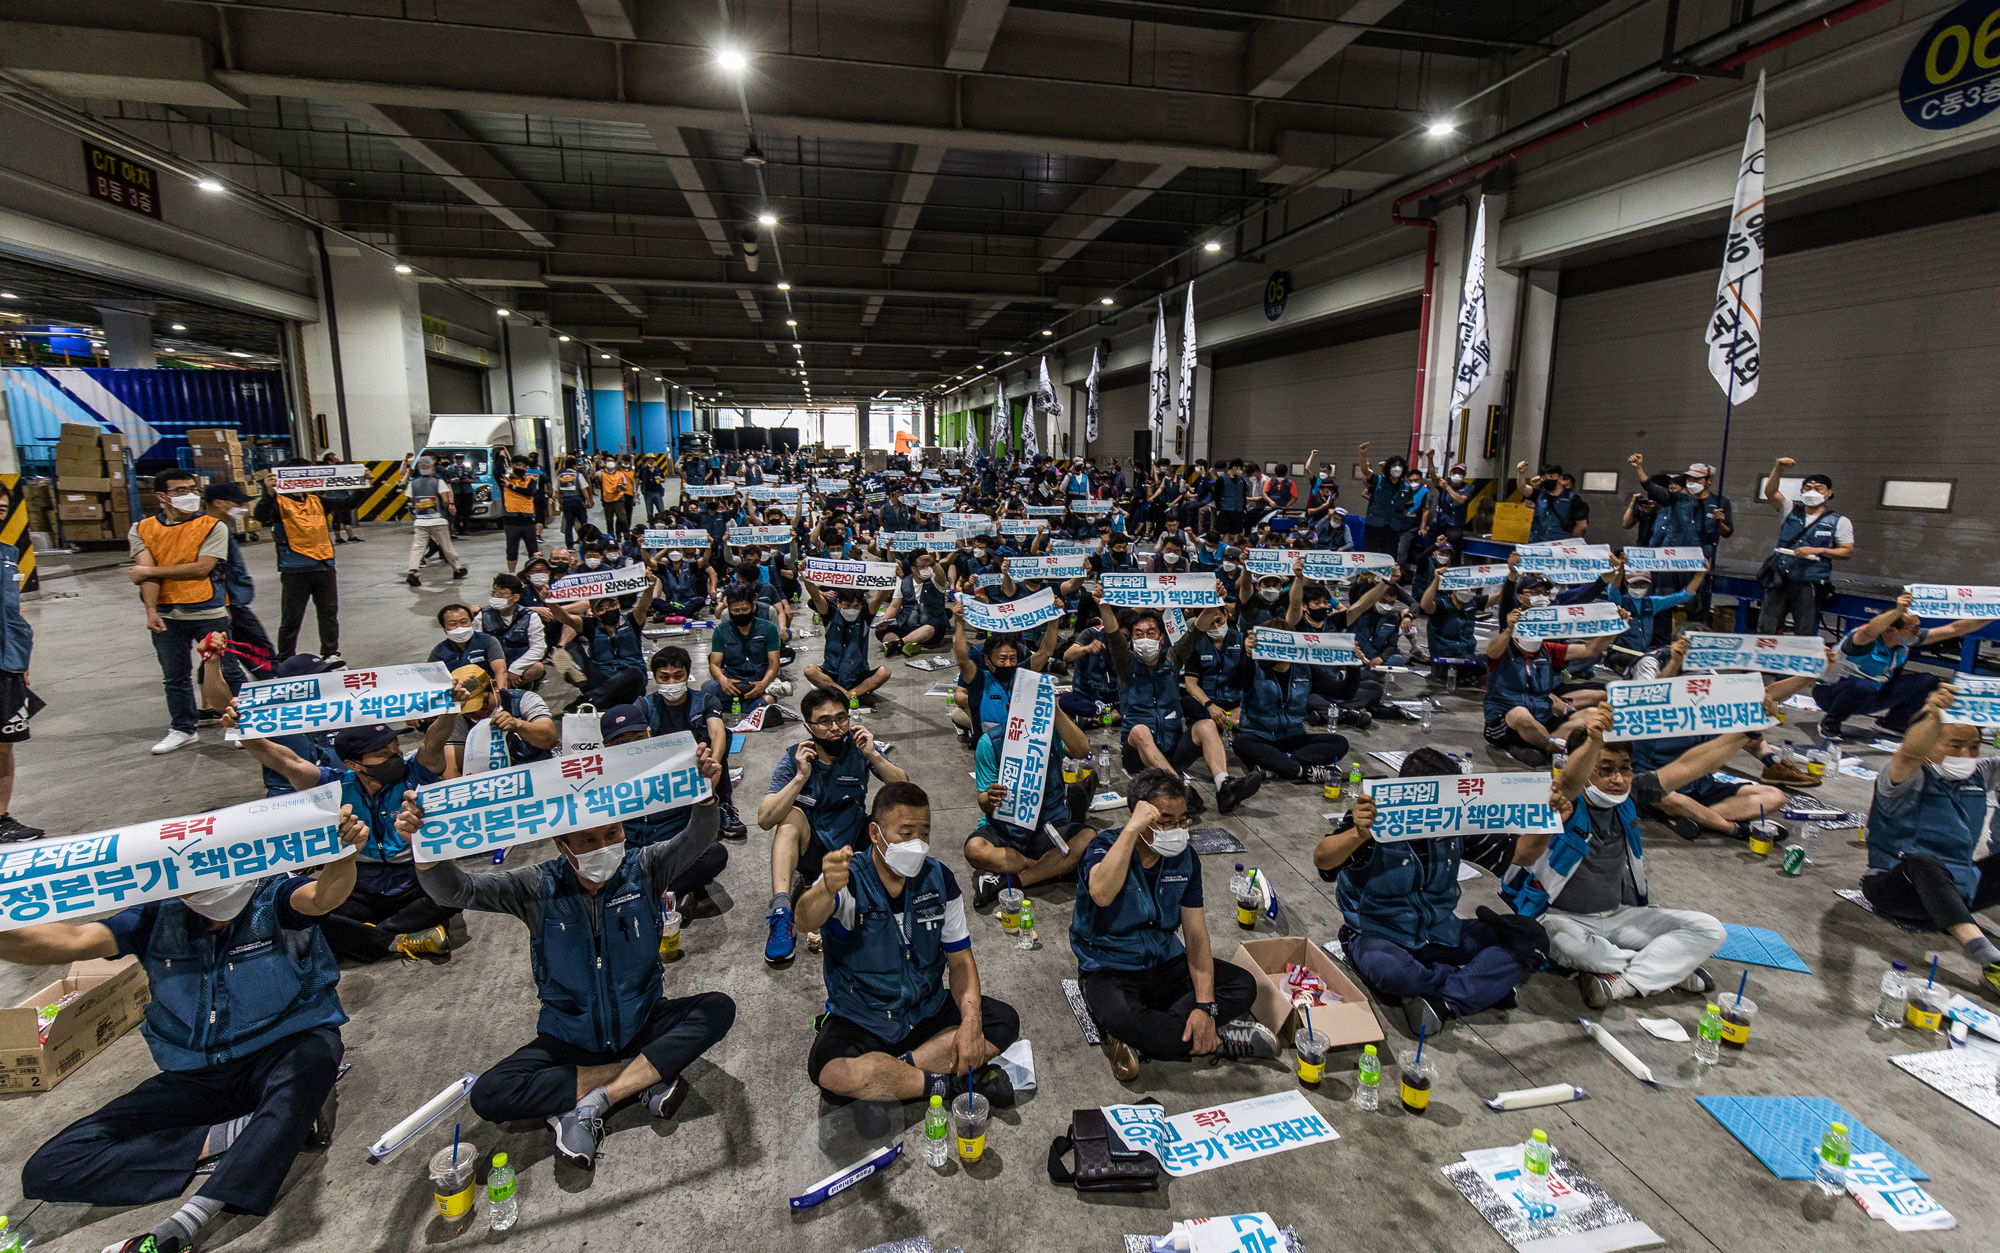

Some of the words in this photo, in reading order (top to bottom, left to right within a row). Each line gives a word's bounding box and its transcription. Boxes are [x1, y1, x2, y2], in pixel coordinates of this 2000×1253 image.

[1925, 8, 2000, 85] 06
[97, 176, 123, 202] B동
[128, 188, 152, 212] 3층
[1268, 278, 1284, 303] 05
[1008, 568, 1048, 578] 우정본부가
[1246, 562, 1290, 573] 우정본부가
[807, 571, 855, 585] 사회적합의
[1103, 577, 1144, 588] 분류작업!
[1158, 575, 1177, 586] 즉각
[549, 584, 603, 600] 사회적합의
[605, 577, 648, 593] 완전승리
[1103, 590, 1165, 605] 우정본부가
[1168, 590, 1220, 605] 책임져라!
[997, 604, 1015, 613] 즉각
[1567, 607, 1585, 617] 즉각
[1910, 601, 1961, 616] 우정본부가
[1303, 634, 1321, 643] 즉각
[1517, 623, 1573, 637] 우정본부가
[1255, 644, 1309, 661] 우정본부가
[343, 672, 377, 690] 즉각
[1686, 679, 1711, 697] 즉각
[238, 681, 315, 708] 분류작업!
[1611, 684, 1669, 706] 분류작업!
[237, 699, 353, 735] 우정본부가
[1612, 706, 1695, 737] 우정본부가
[1008, 716, 1024, 741] 즉각
[561, 755, 603, 780] 즉각
[1018, 738, 1048, 824] 우정본부가
[1457, 778, 1485, 796] 즉각
[423, 773, 526, 811] 분류작업!
[1374, 783, 1436, 805] 분류작업!
[421, 794, 578, 855] 우정본부가
[585, 767, 706, 818] 책임져라!
[1371, 806, 1463, 838] 우정본부가
[1467, 803, 1557, 830] 책임져라!
[159, 816, 216, 841] 즉각
[0, 835, 109, 877] 류작업!
[0, 857, 180, 922] 정본부가
[188, 823, 349, 881] 책임져라
[31, 1077, 40, 1086] 2
[1192, 1109, 1231, 1127] 즉각
[1223, 1115, 1329, 1153] 책임져라!
[855, 1167, 873, 1179] Face
[831, 1177, 854, 1193] Shield
